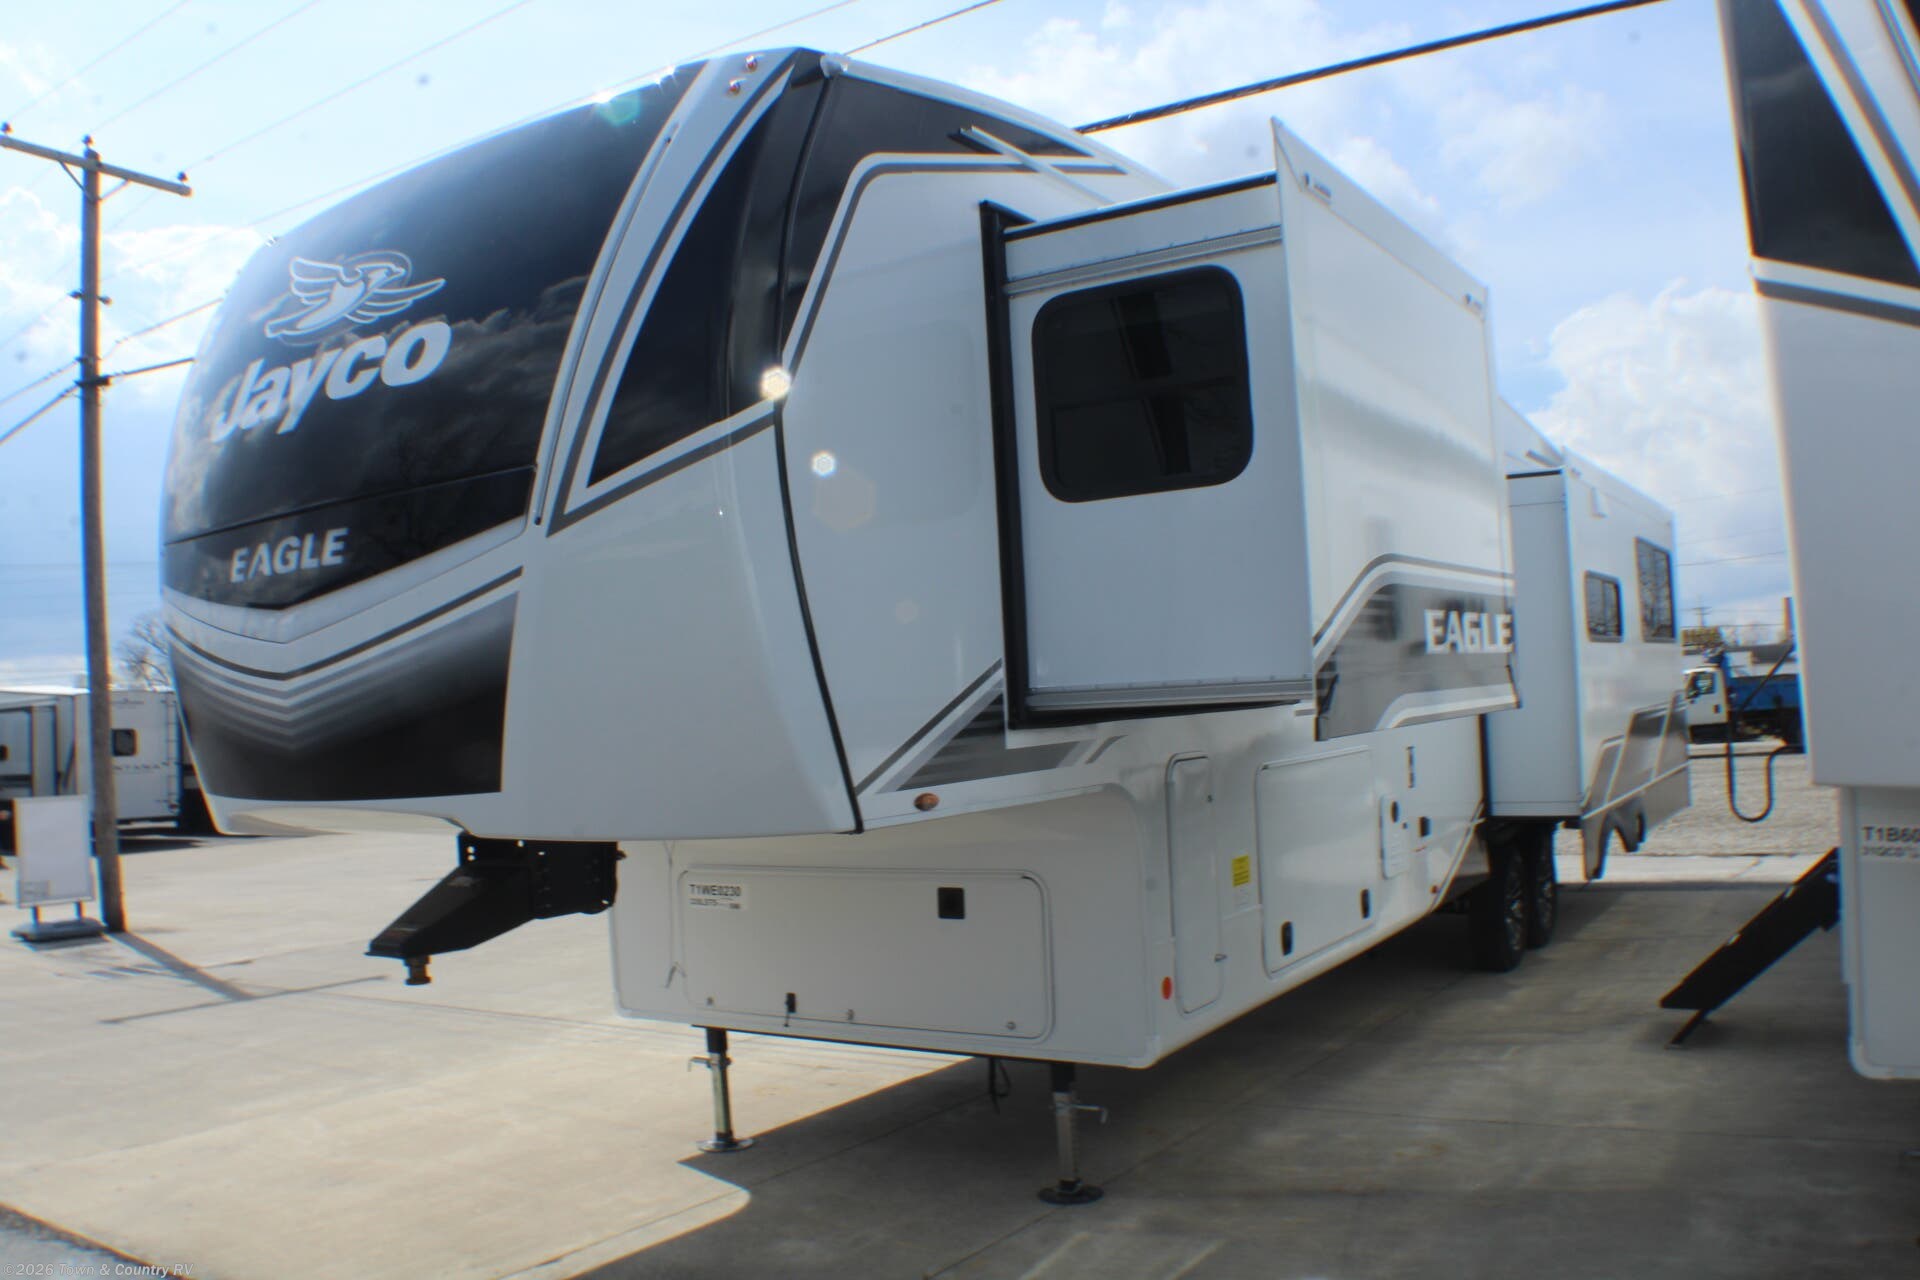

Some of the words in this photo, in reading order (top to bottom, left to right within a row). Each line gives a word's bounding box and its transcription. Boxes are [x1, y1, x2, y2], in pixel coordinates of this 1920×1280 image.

[210, 321, 452, 443] Jayco
[229, 527, 349, 583] EAGLE
[1424, 608, 1515, 655] EAGLE
